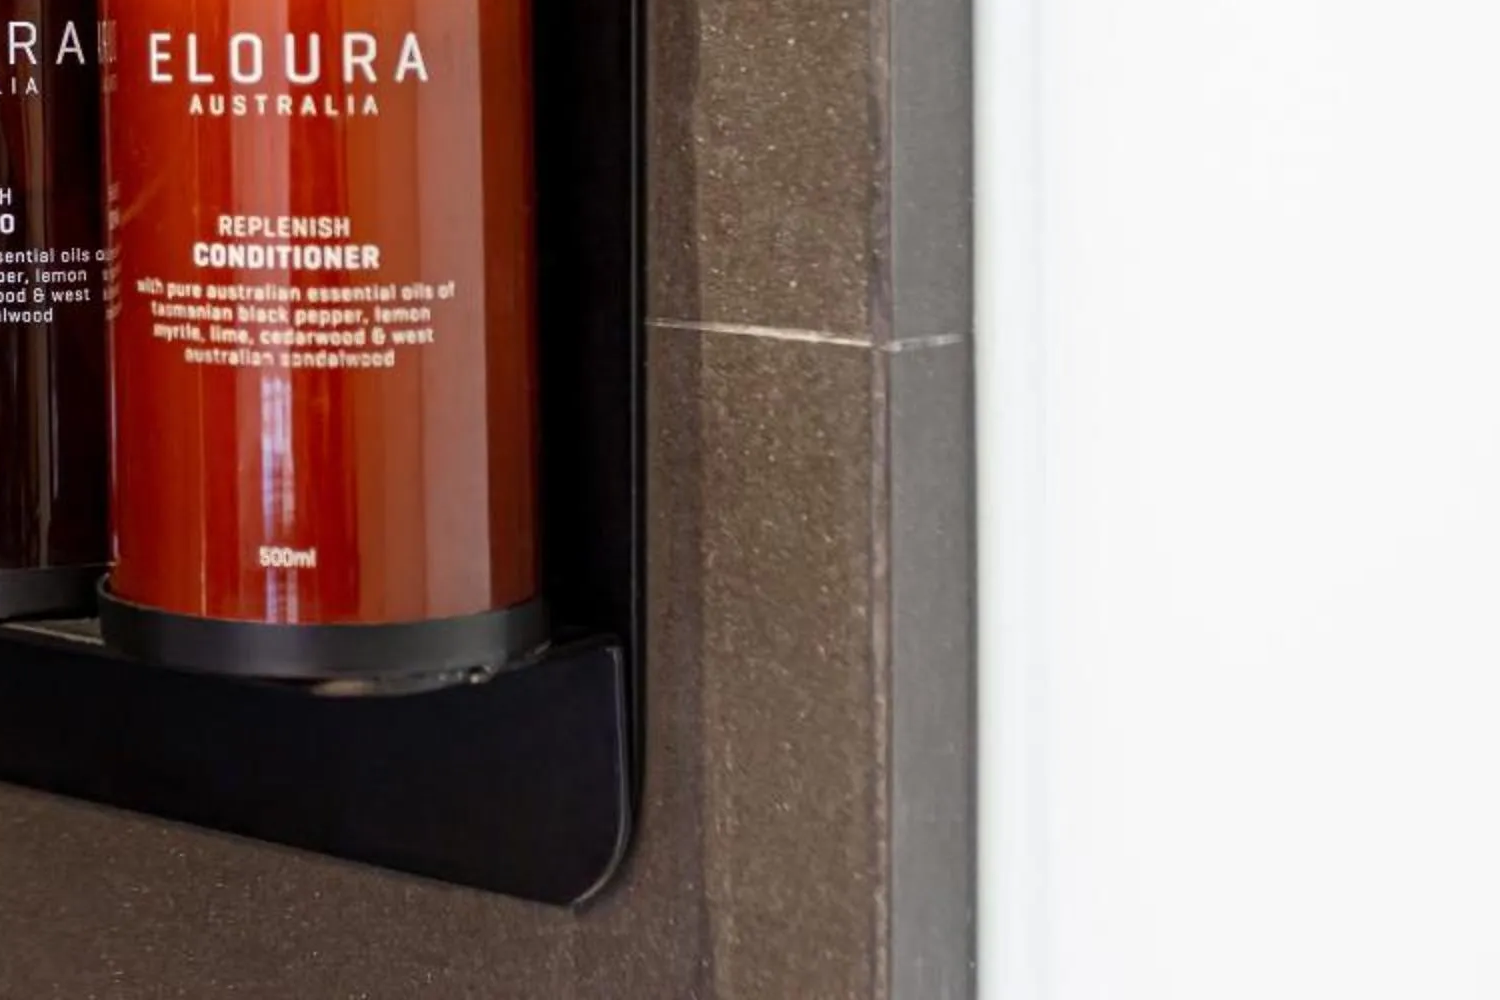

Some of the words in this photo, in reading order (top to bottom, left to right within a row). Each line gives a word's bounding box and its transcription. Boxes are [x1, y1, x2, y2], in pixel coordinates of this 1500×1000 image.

[148, 32, 430, 85] ELOURA
[189, 94, 380, 117] AUSTRALIA
[218, 216, 351, 240] REPLENISH
[60, 247, 91, 263] oils
[193, 242, 381, 271] CONDITIONER
[35, 267, 88, 283] lemon
[32, 286, 46, 303] &
[51, 287, 91, 303] west
[166, 282, 202, 299] pure
[206, 283, 301, 301] australian
[306, 284, 397, 303] essential
[401, 282, 435, 301] oils
[437, 280, 456, 300] of
[151, 300, 234, 322] tasmanian
[236, 304, 290, 323] black
[294, 307, 370, 328] pepper,
[374, 304, 432, 323] lemon
[209, 323, 255, 346] lime,
[259, 327, 367, 346] cedarwood
[184, 347, 275, 367] australian
[280, 349, 396, 369] sandalwood
[259, 545, 317, 569] 500ml
